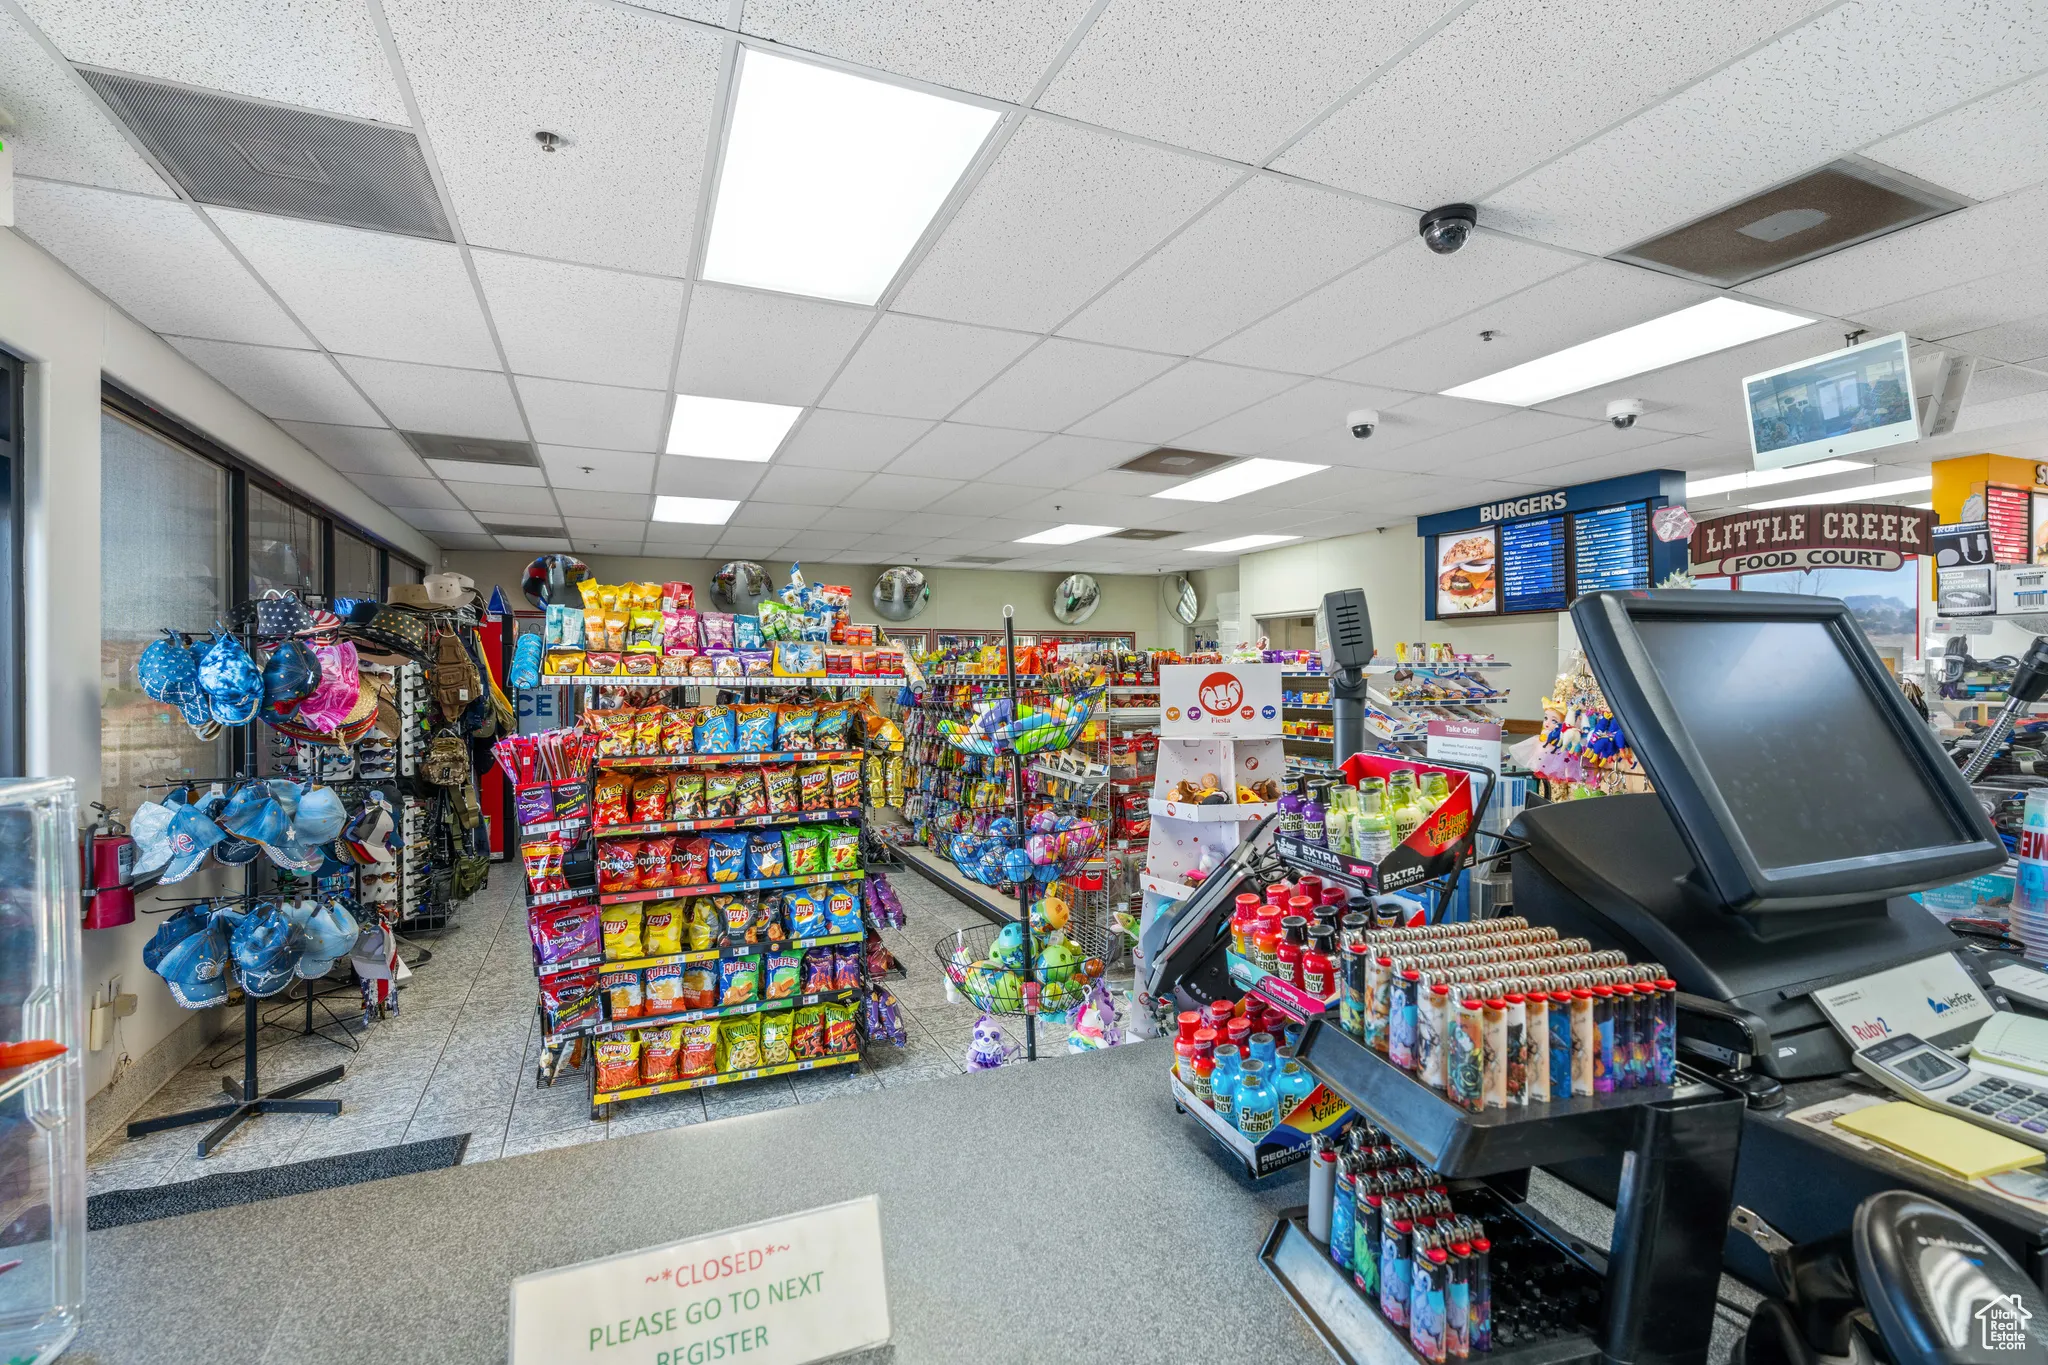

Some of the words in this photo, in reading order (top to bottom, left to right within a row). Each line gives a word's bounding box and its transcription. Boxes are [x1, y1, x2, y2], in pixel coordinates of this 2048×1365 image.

[1480, 491, 1567, 522] BURGERS
[1707, 512, 1805, 553] LITTLE
[1823, 511, 1921, 544] CREEK
[1735, 551, 1798, 572] FOOD
[1806, 550, 1887, 567] COURT
[519, 694, 553, 717] CE
[737, 708, 769, 726] Cheetos
[1211, 716, 1232, 724] Fiesta
[1445, 724, 1461, 733] Take
[1462, 725, 1480, 735] One!
[832, 770, 859, 787] Fritos
[634, 785, 666, 801] Cheetos
[518, 802, 539, 810] Doritos
[1280, 821, 1304, 831] ENERG
[1438, 810, 1469, 832] 5-hour
[1435, 820, 1468, 845] ENERGY
[709, 847, 742, 858] Doritos
[750, 840, 783, 853] Doritos
[670, 853, 702, 863] Doritos
[1301, 845, 1341, 865] EXTRA
[600, 859, 635, 870] Doritos
[1303, 854, 1342, 873] STRENGTH
[1351, 864, 1370, 876] Berry
[1383, 864, 1425, 883] EXTRA
[1383, 873, 1425, 890] STRENGTH
[578, 888, 593, 896] SNACK
[830, 898, 852, 911] Lay's
[552, 921, 566, 929] JACK
[566, 918, 584, 926] LINK'S
[647, 914, 671, 927] Lay's
[549, 935, 573, 946] Doritos
[724, 961, 757, 975] RUFFLES
[767, 956, 799, 970] RUFFLES
[645, 964, 681, 981] RUFFLES
[600, 973, 637, 988] RUFFLES
[1269, 980, 1282, 993] Great
[1281, 986, 1299, 1002] Tasting
[1942, 992, 1976, 1008] VeriFone
[725, 1024, 759, 1041] FUNYUNS
[1852, 1016, 1892, 1042] Ruby2
[599, 1044, 632, 1057] CHESTER'S
[1241, 1107, 1274, 1121] 5-hour
[1240, 1119, 1274, 1132] ENERGY
[589, 1307, 678, 1352] PLEASE
[686, 1297, 721, 1325] GO
[729, 1291, 762, 1315] TO
[768, 1270, 825, 1305] NEXT
[656, 1325, 769, 1365] REGISTER
